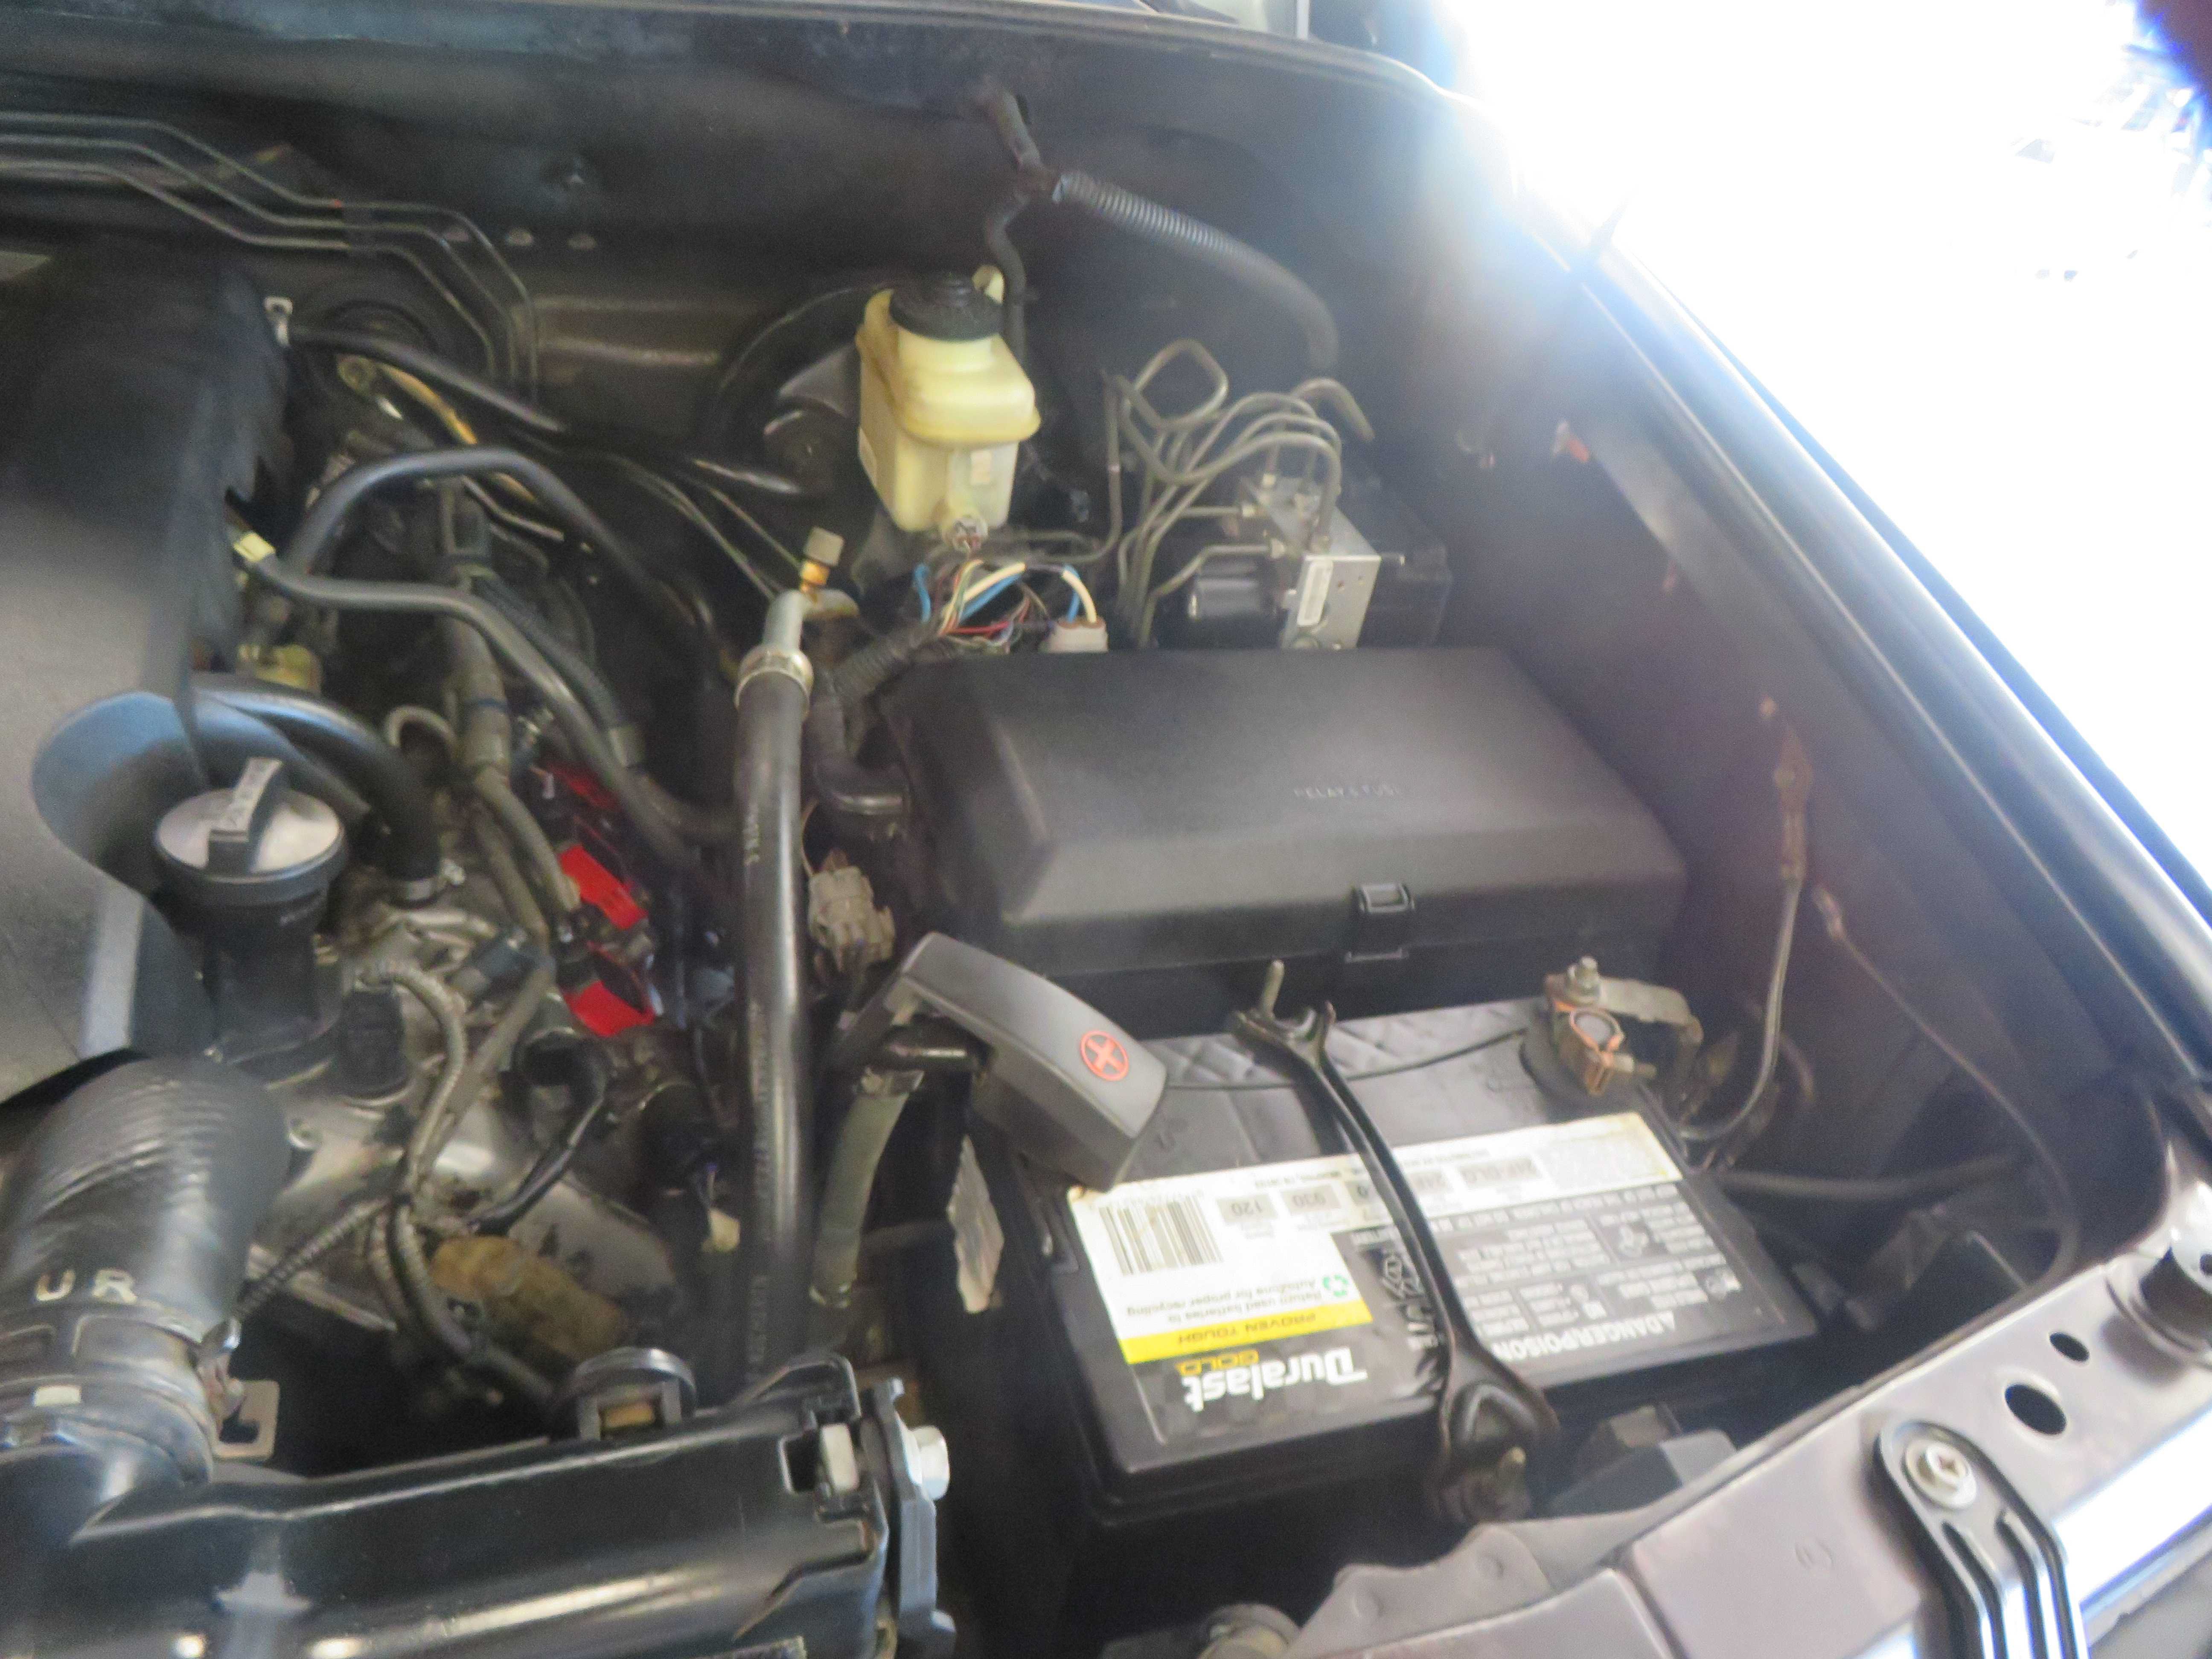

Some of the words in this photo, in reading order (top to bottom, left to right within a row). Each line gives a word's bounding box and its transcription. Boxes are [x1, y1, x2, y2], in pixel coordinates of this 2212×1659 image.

[1230, 1200, 1264, 1218] 120
[1245, 1313, 1316, 1333] PROVEN
[1176, 1327, 1238, 1345] TOUGH
[1175, 1349, 1259, 1377] GOLD
[1181, 1347, 1368, 1413] Duralast
